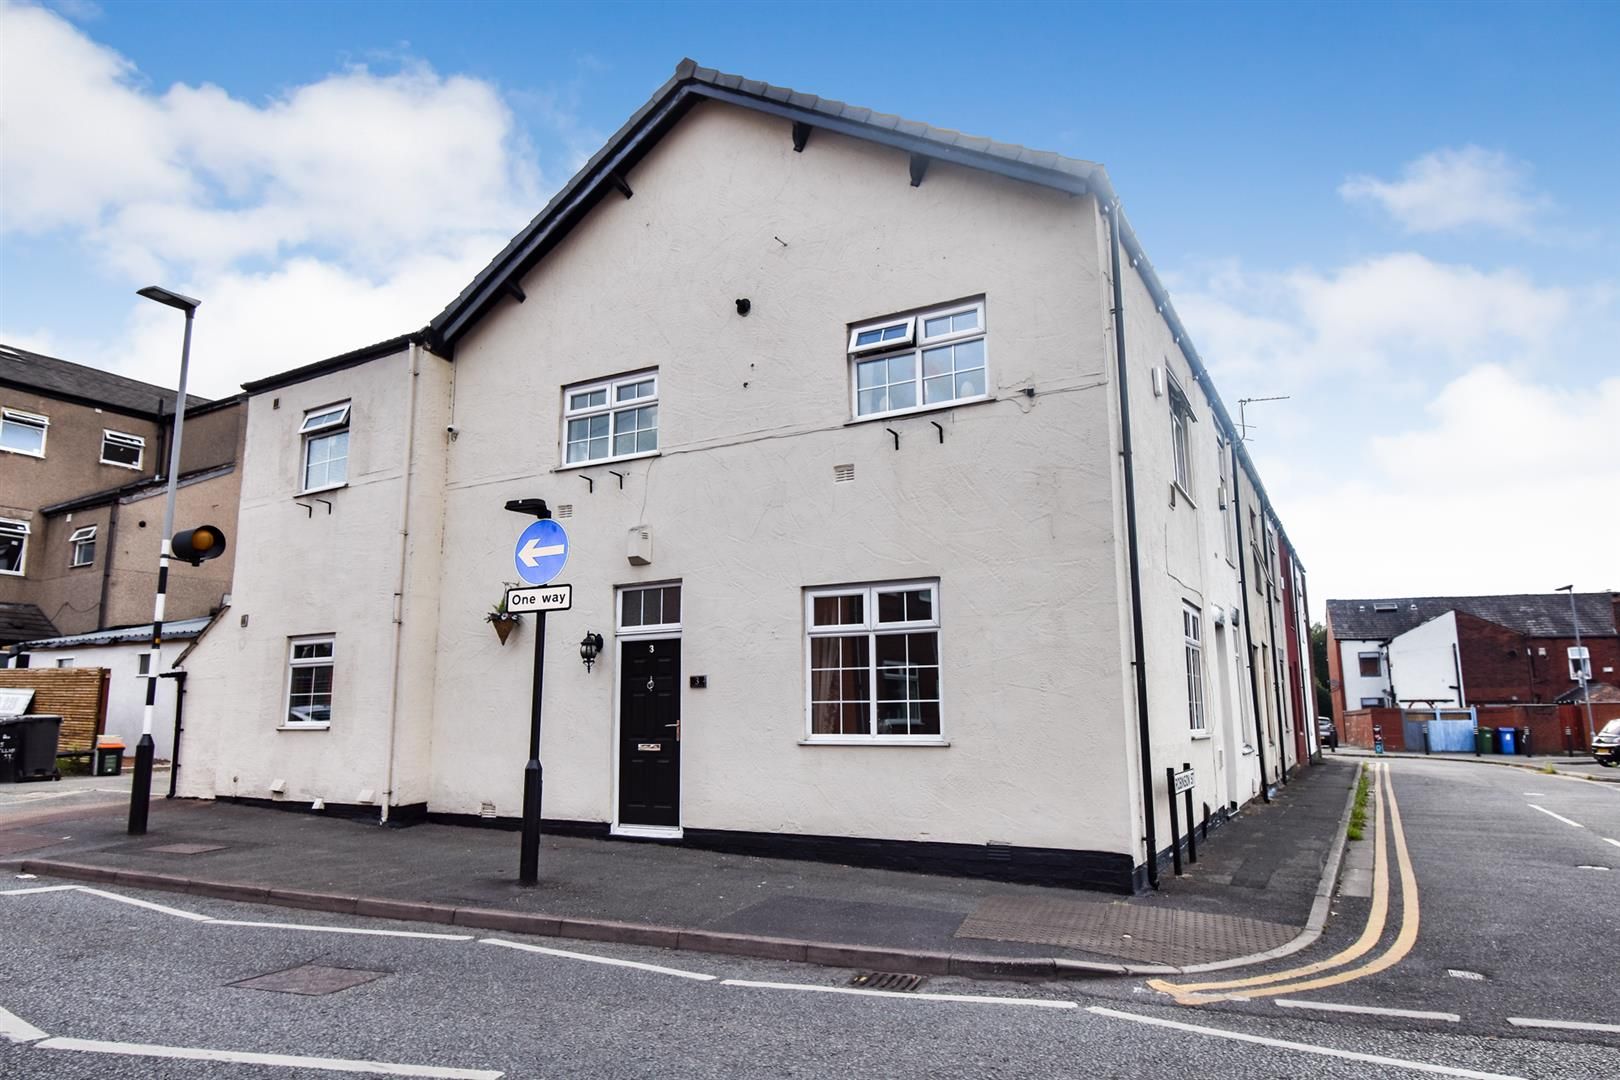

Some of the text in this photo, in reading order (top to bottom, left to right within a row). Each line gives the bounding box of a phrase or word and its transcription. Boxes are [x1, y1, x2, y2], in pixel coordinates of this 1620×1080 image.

[512, 593, 566, 605] One way
[649, 644, 655, 653] 3
